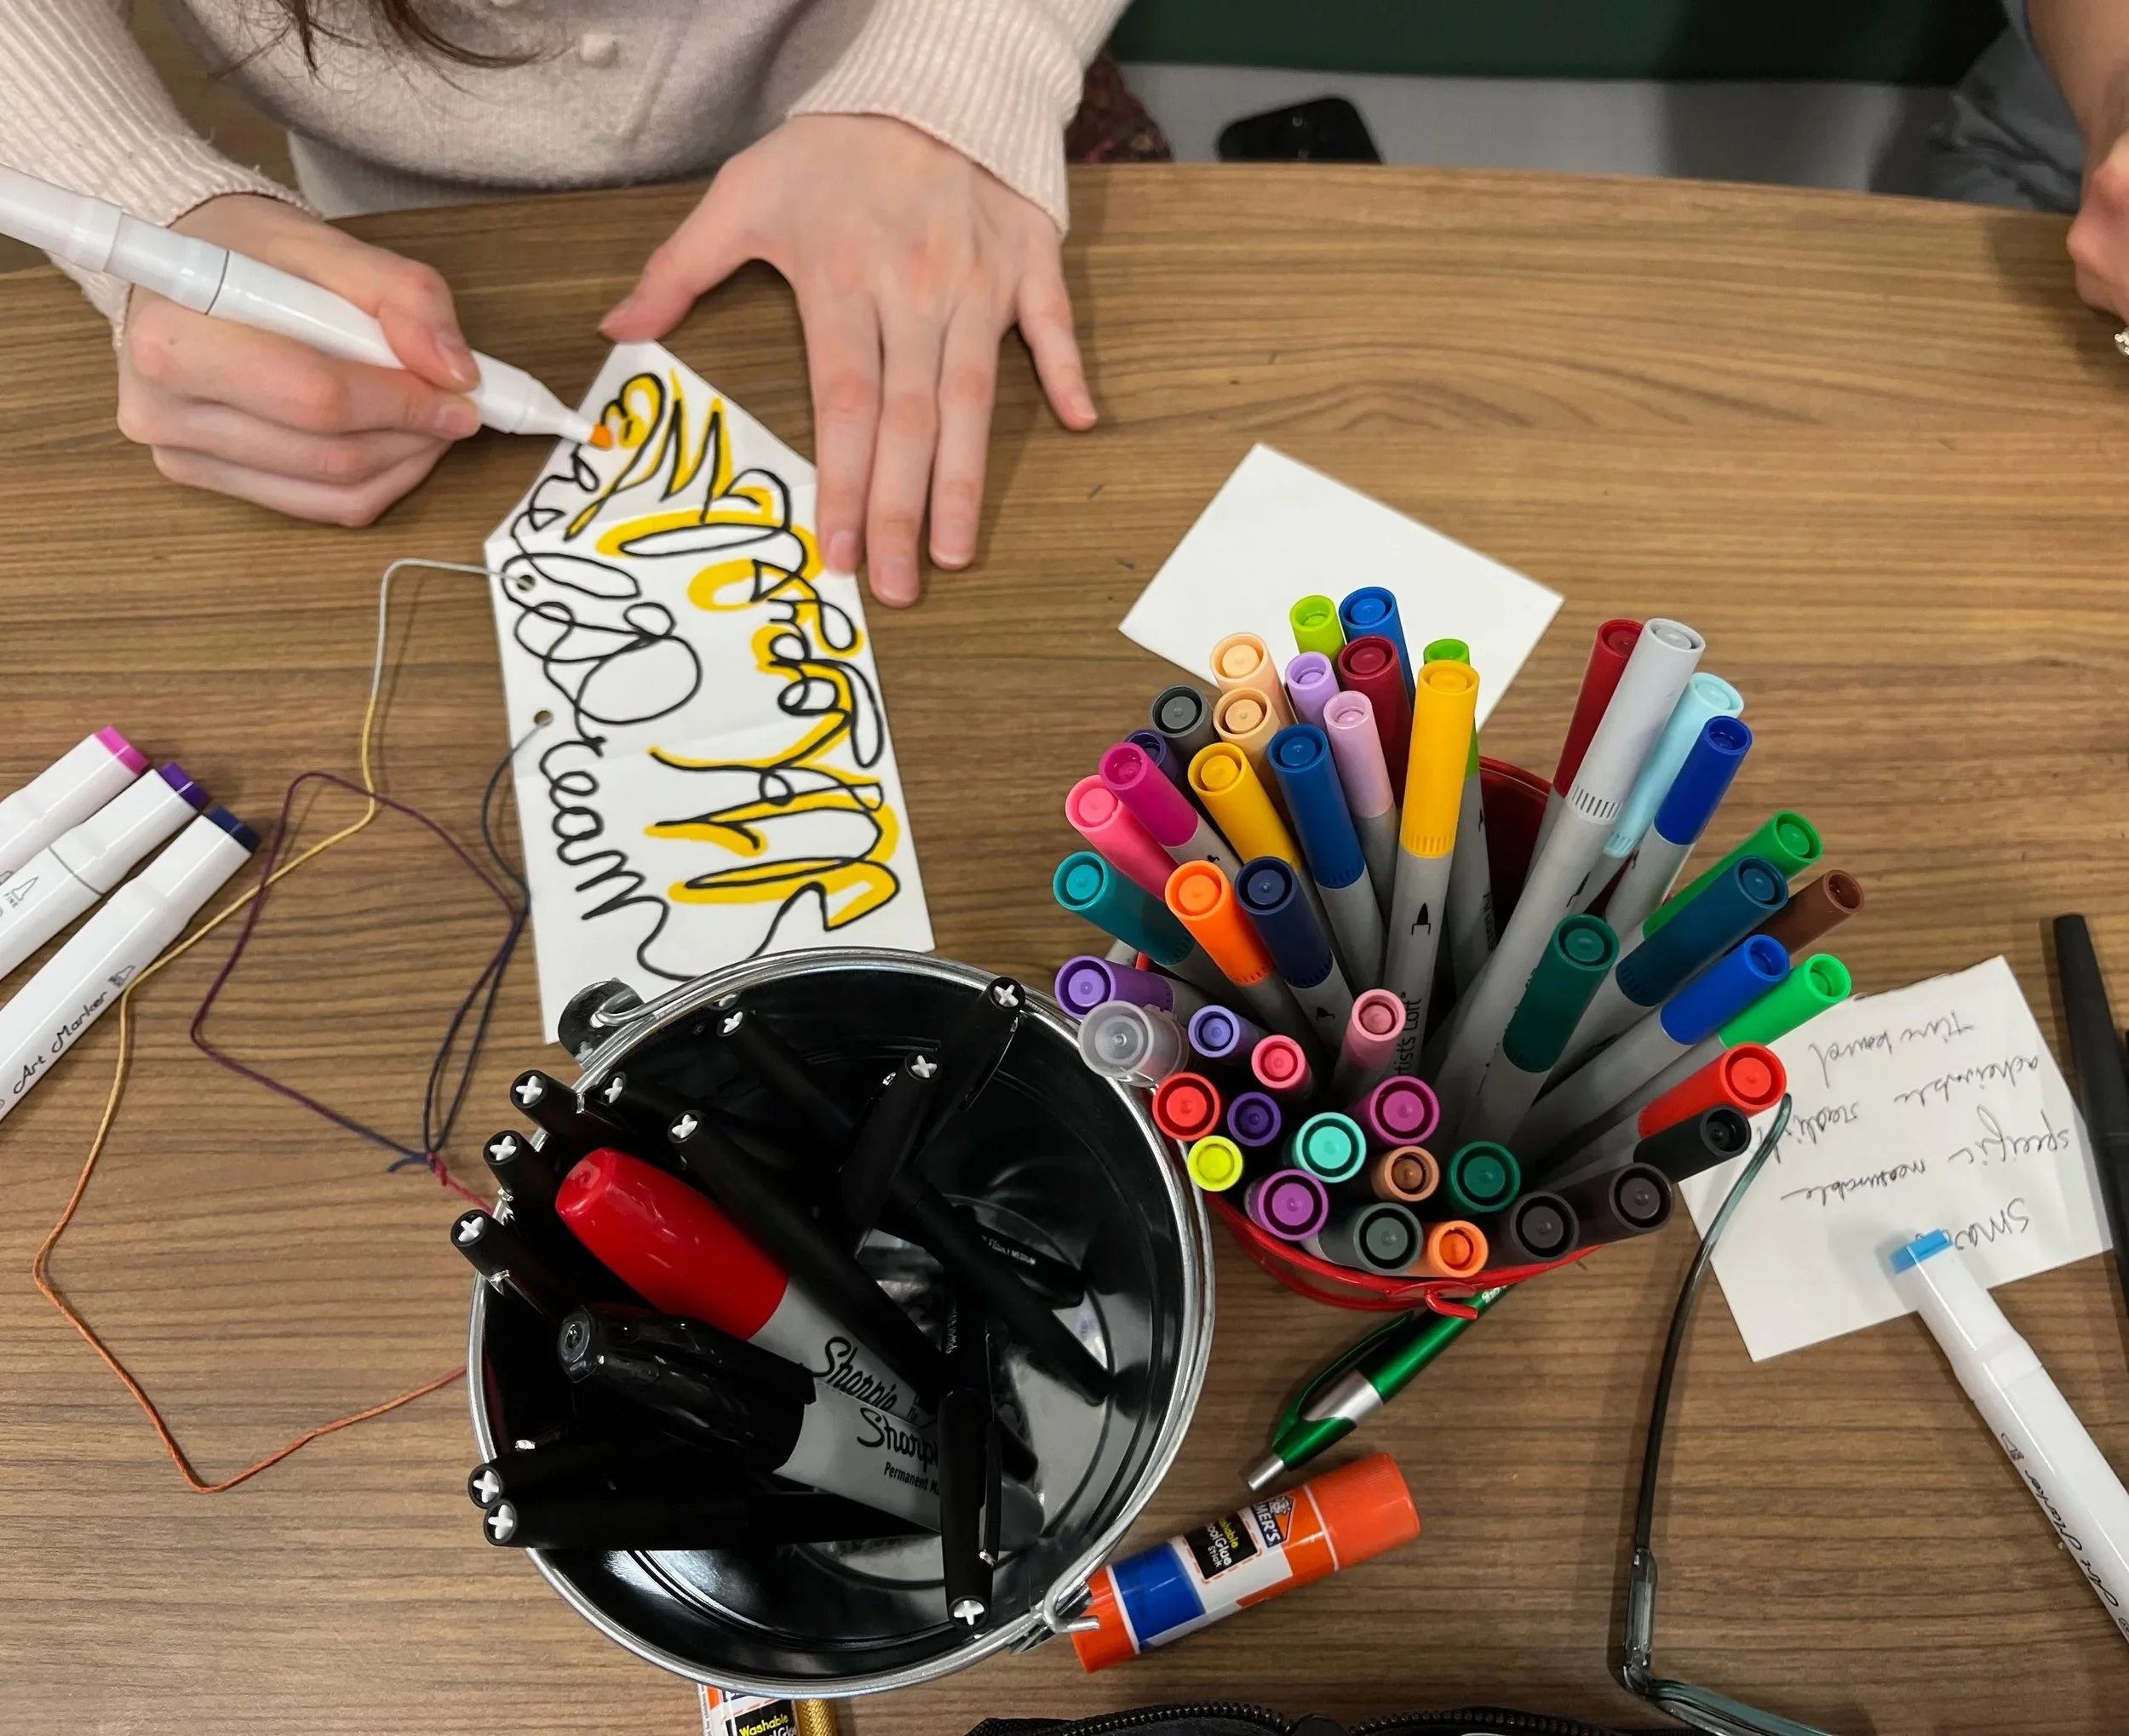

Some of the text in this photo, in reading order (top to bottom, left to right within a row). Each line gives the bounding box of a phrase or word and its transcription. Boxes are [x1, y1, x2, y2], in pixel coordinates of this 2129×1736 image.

[14, 991, 107, 1094] Art Marker
[812, 1336, 898, 1412] Sharpie
[884, 1461, 929, 1490] Permanent
[1208, 1545, 1222, 1567] Stick
[2025, 1470, 2119, 1607] Art Marker
[739, 1713, 789, 1736] Washable
